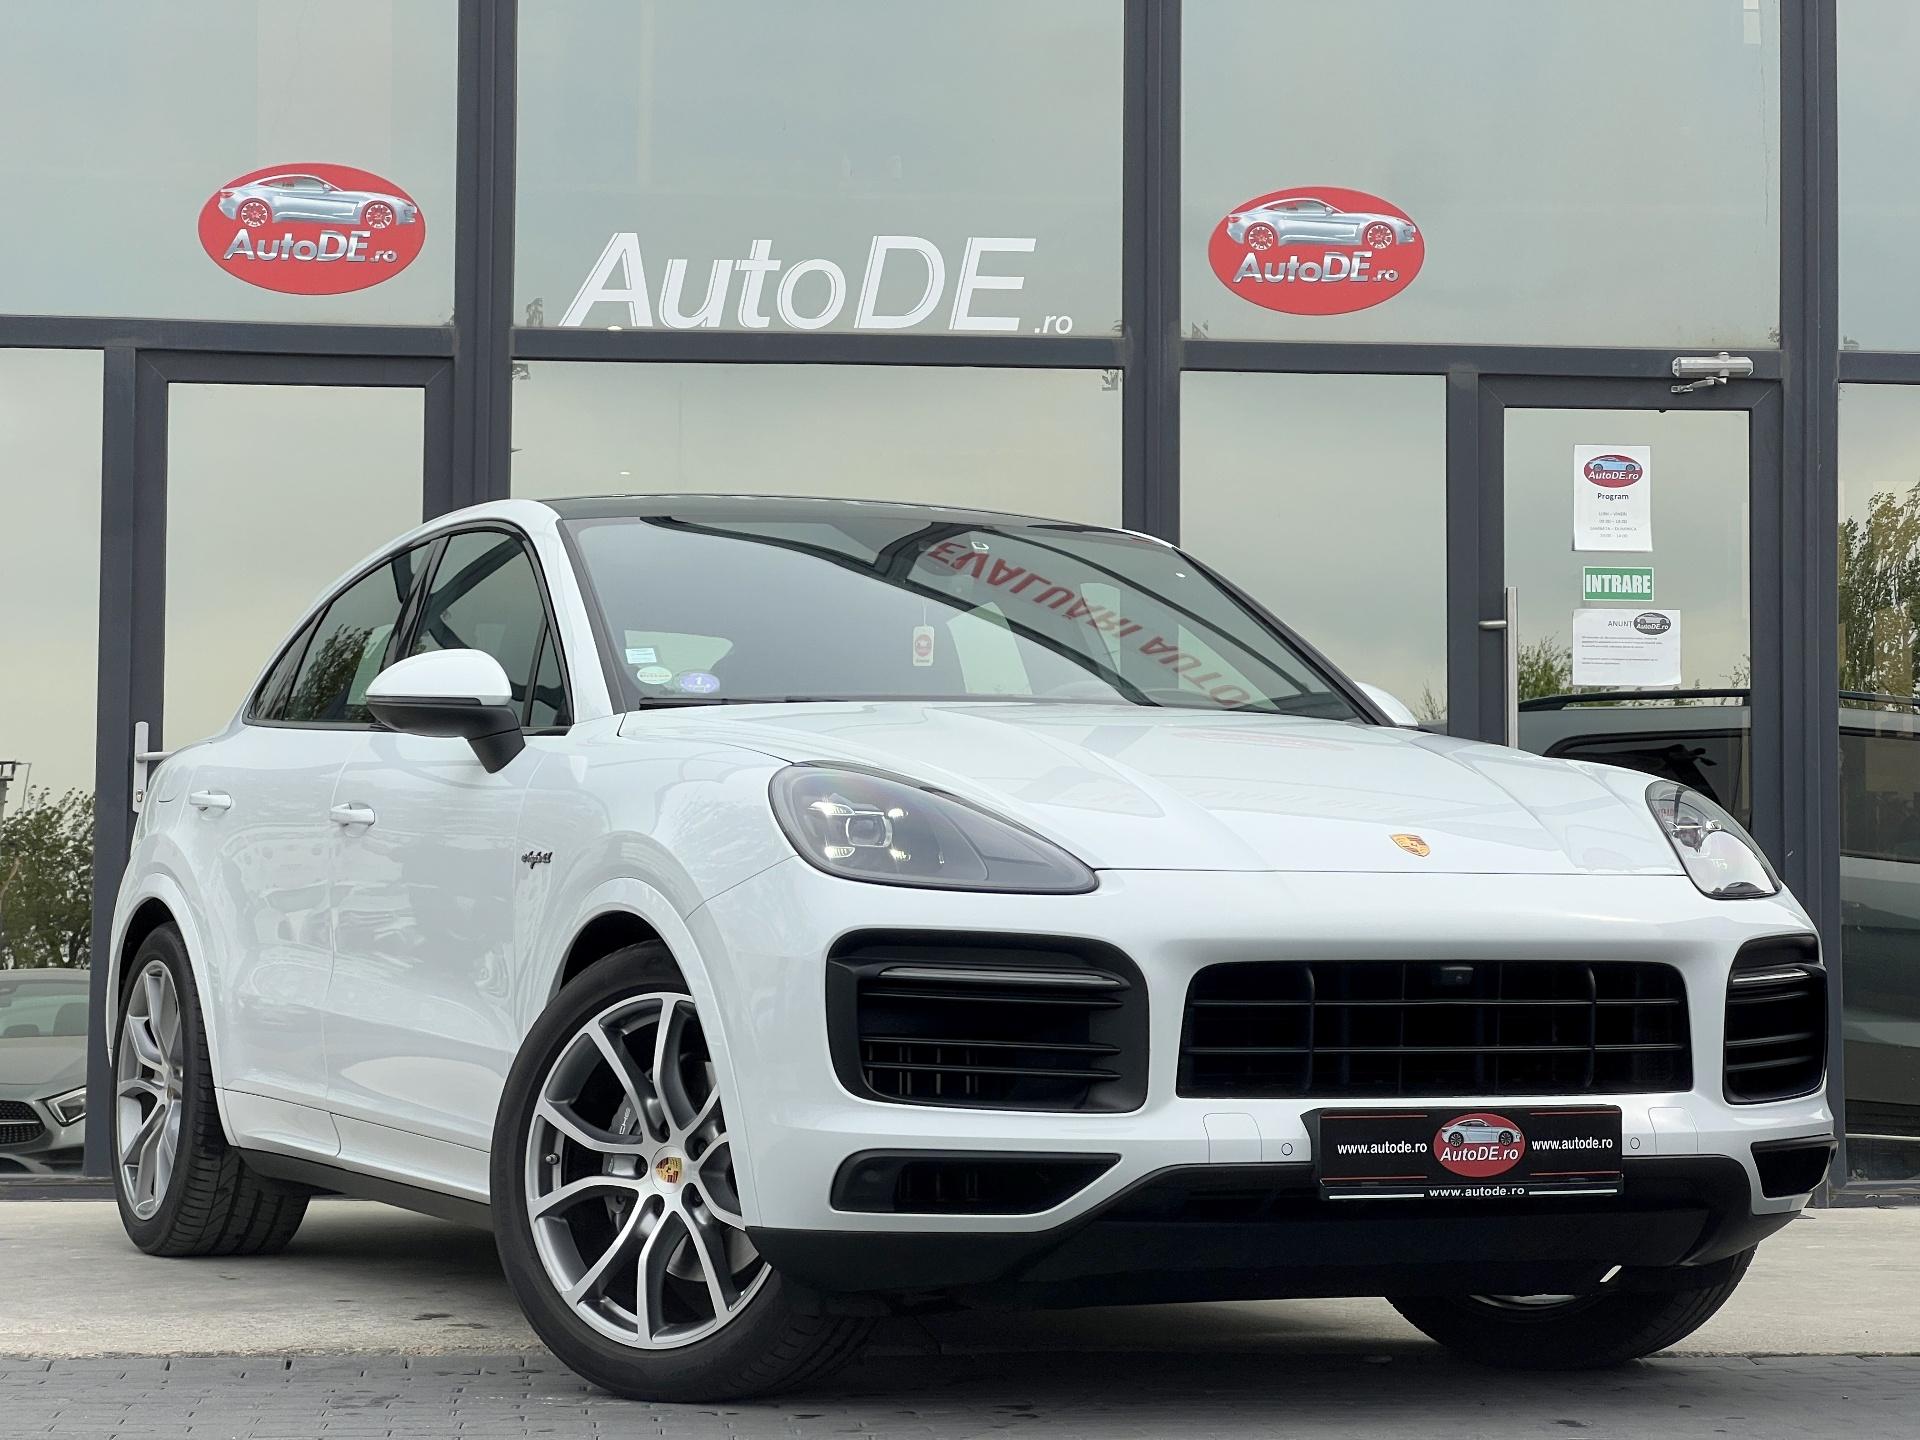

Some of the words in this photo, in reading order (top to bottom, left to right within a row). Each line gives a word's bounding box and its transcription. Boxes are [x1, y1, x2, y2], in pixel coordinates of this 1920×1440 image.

[1597, 492, 1630, 502] Program
[1585, 574, 1651, 594] INTRARE
[1337, 1141, 1428, 1155] www.autode.ro
[1532, 1137, 1613, 1151] www.autode.ro
[1440, 1146, 1519, 1162] AutoDE.ro
[1429, 1185, 1525, 1198] www.autode.ro
